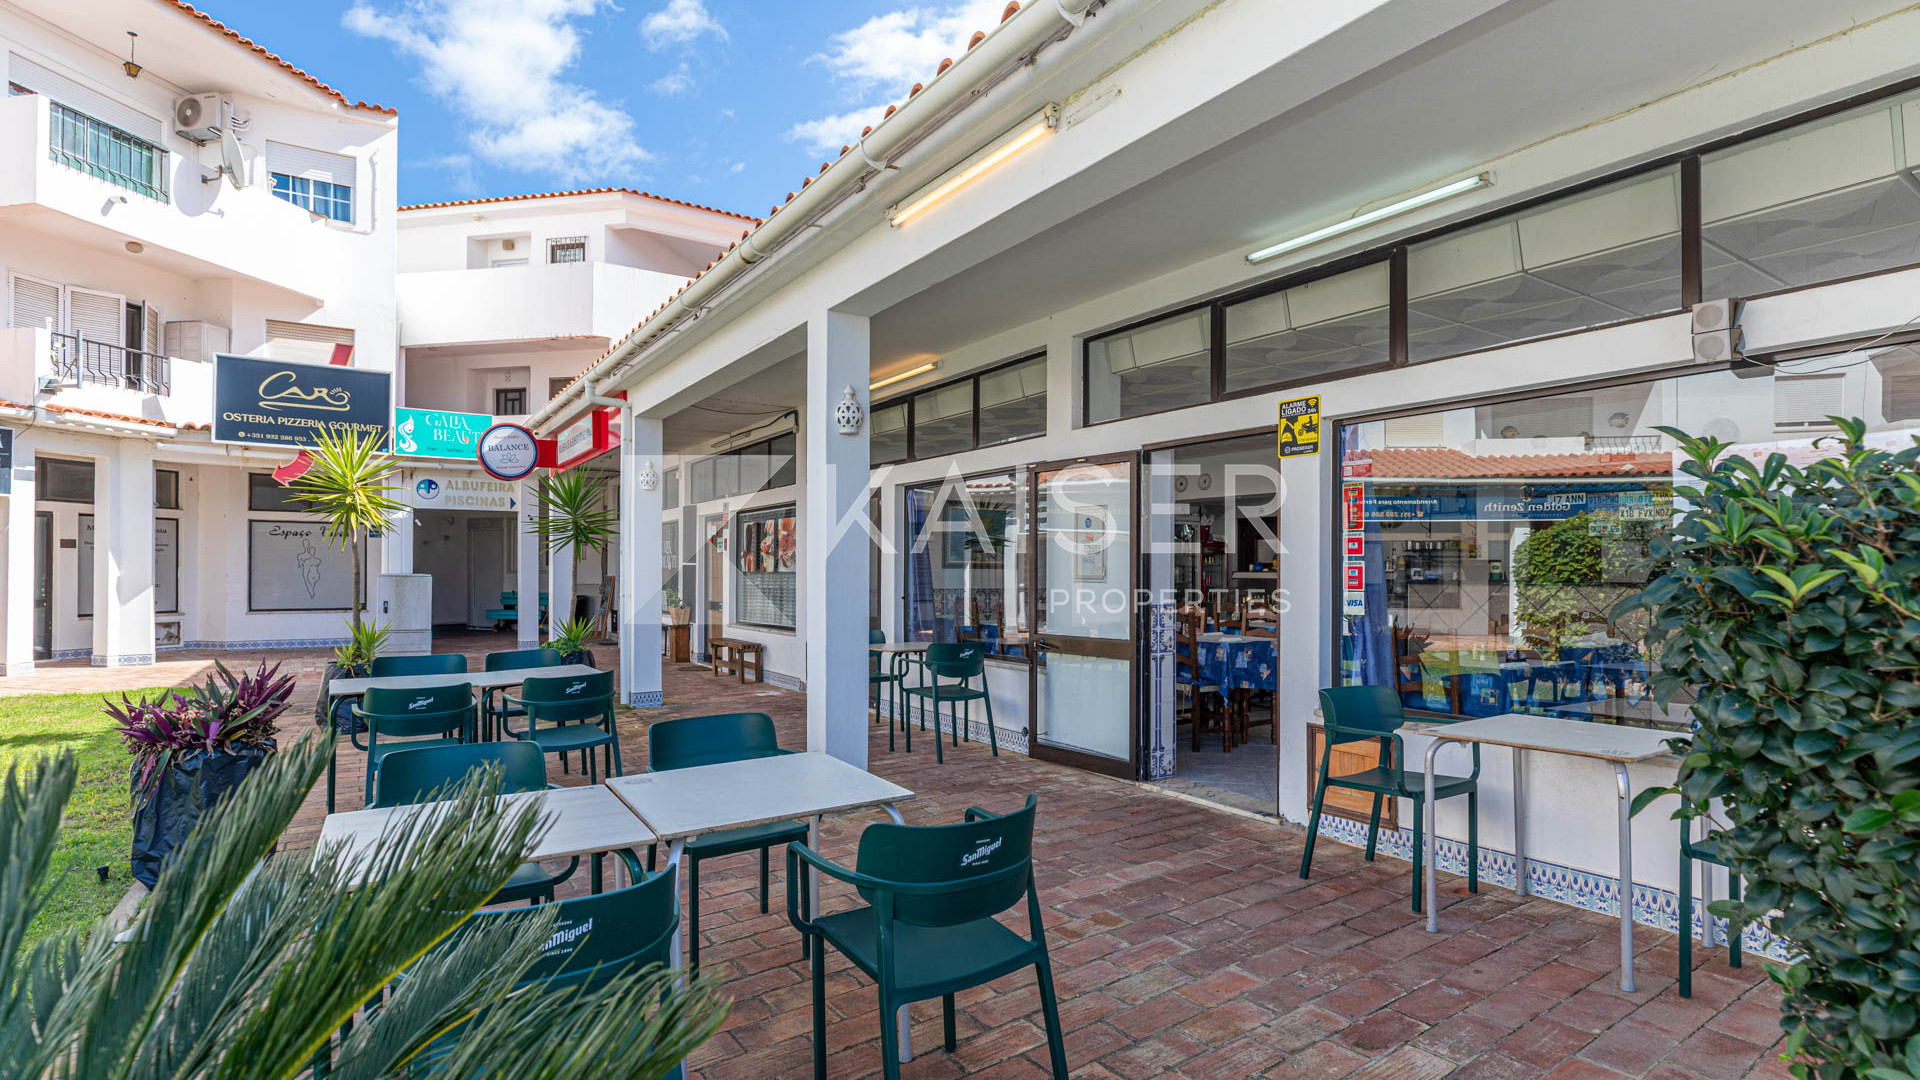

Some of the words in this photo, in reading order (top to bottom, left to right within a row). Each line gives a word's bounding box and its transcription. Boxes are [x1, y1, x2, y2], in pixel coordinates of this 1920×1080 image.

[1282, 400, 1306, 409] ALARME
[1281, 406, 1307, 416] LIGADO
[223, 411, 276, 425] OSTERIA
[277, 416, 327, 429] PIZZERIA
[328, 420, 384, 433] GOURMET
[433, 428, 482, 445] BEAUT
[488, 443, 530, 452] BALANCE
[444, 480, 515, 493] ALBUFEIRA
[444, 495, 505, 507] PISCINAS
[1638, 509, 1653, 518] FVX
[269, 525, 312, 540] Espaço
[1346, 599, 1364, 607] VISA
